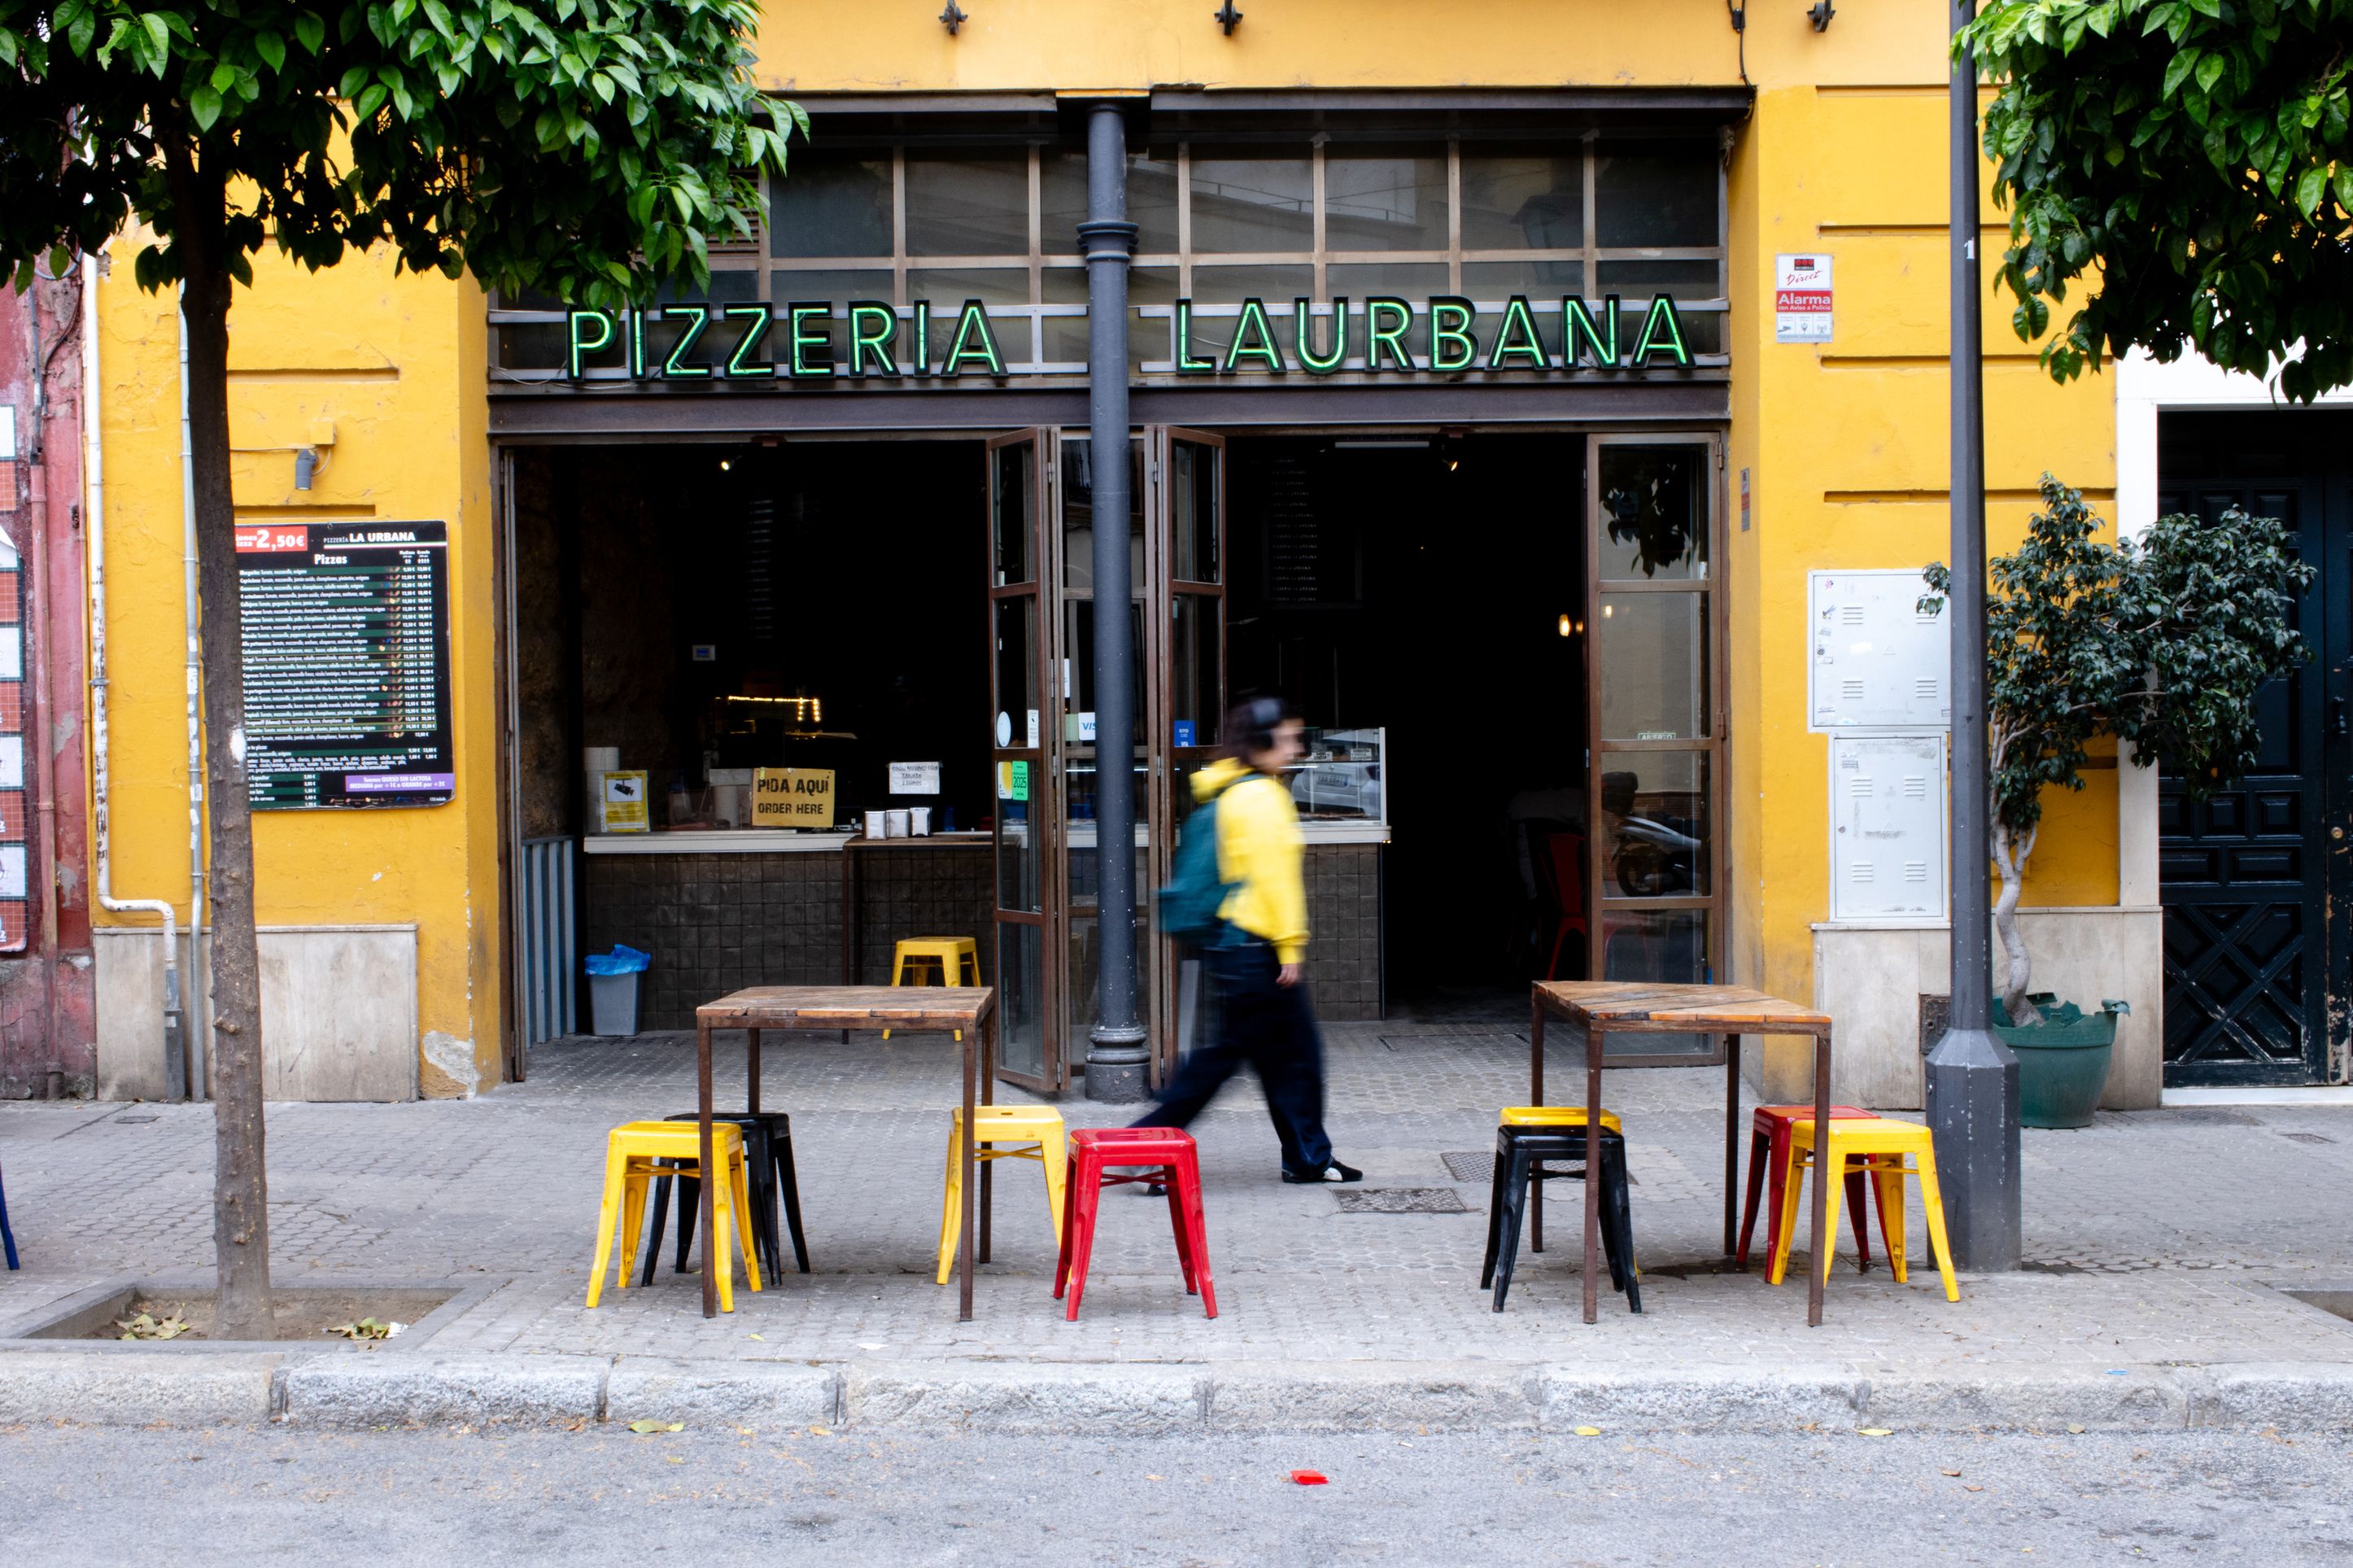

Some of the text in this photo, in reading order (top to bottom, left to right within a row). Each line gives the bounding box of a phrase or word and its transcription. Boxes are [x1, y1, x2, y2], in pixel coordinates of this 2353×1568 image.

[1785, 270, 1823, 286] Direct
[1779, 293, 1831, 304] Alarma
[565, 299, 1009, 382] PIZZERIA
[349, 533, 365, 543] LA
[367, 531, 416, 542] URBANA
[314, 553, 348, 565] Pizzas
[757, 775, 830, 796] PIDA AQUÍ
[1013, 776, 1027, 788] 2025
[758, 802, 823, 815] ORDER HERE
